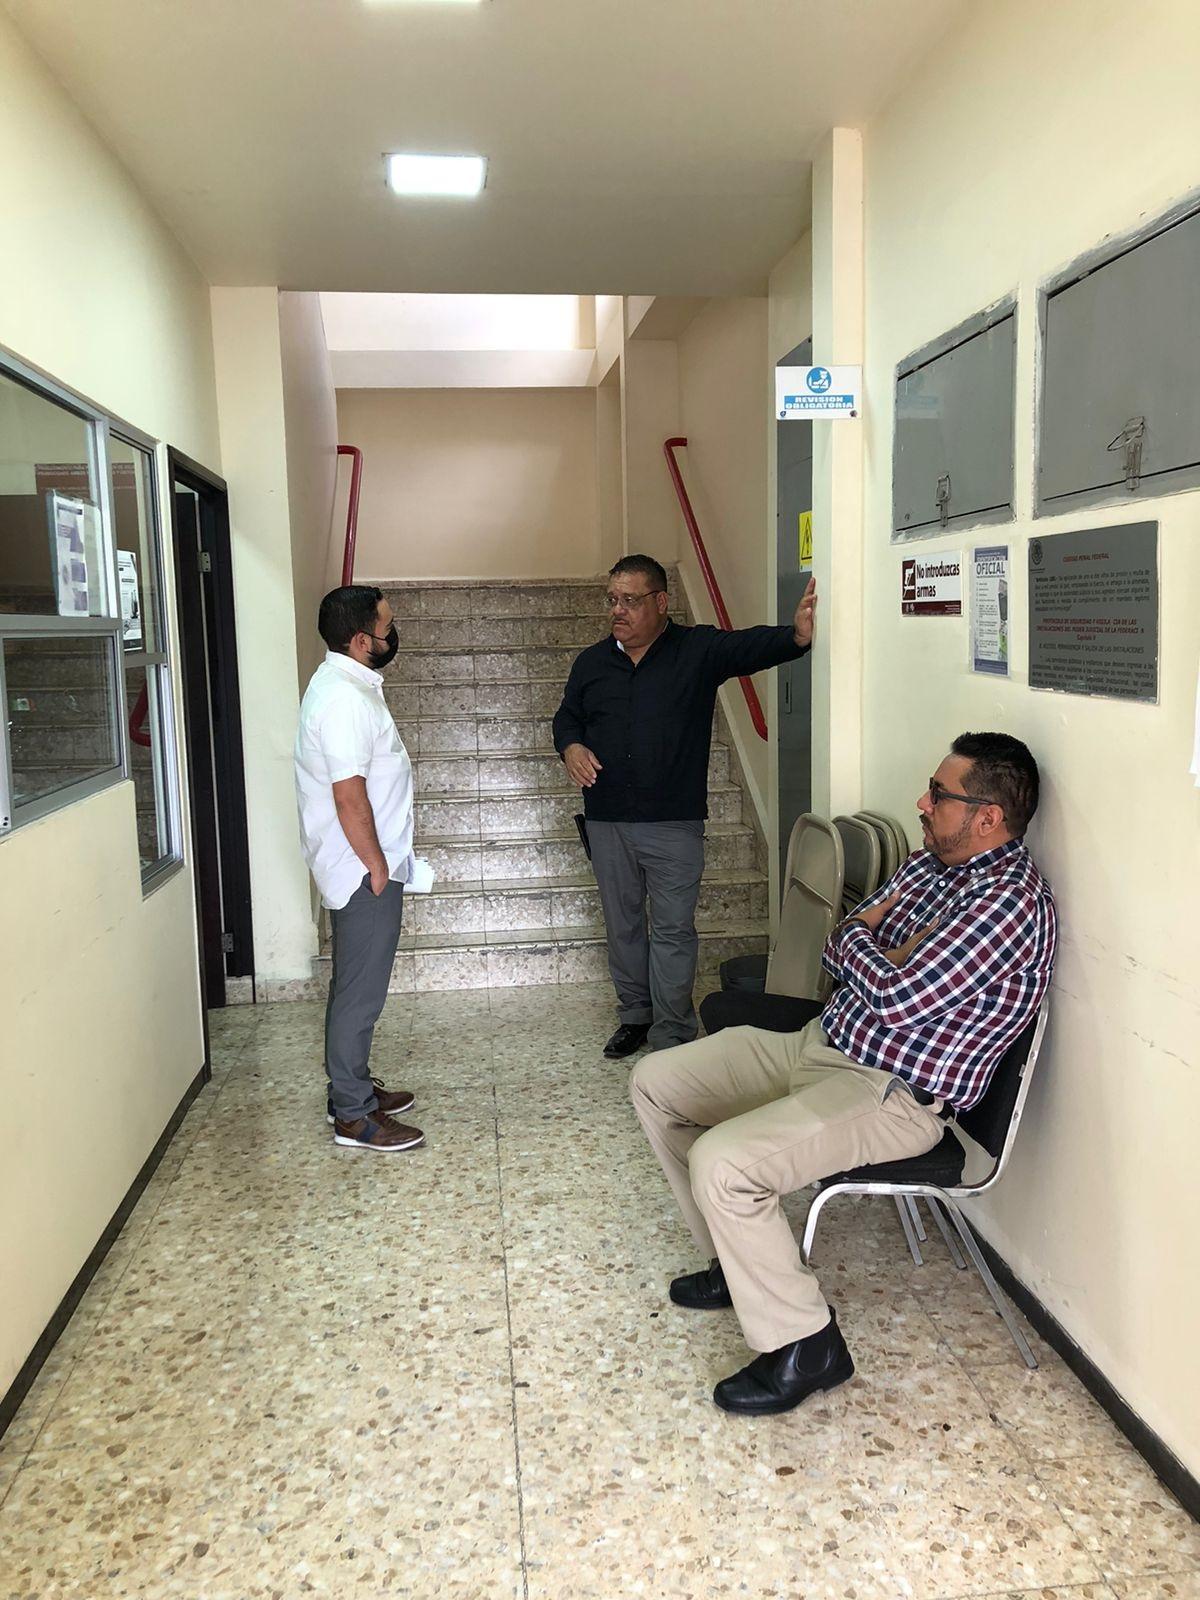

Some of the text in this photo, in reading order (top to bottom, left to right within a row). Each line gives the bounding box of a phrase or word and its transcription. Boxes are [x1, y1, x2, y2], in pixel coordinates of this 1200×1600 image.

[917, 561, 960, 579] No introduzcas
[976, 562, 1005, 575] OFICIAL
[917, 585, 936, 598] armas
